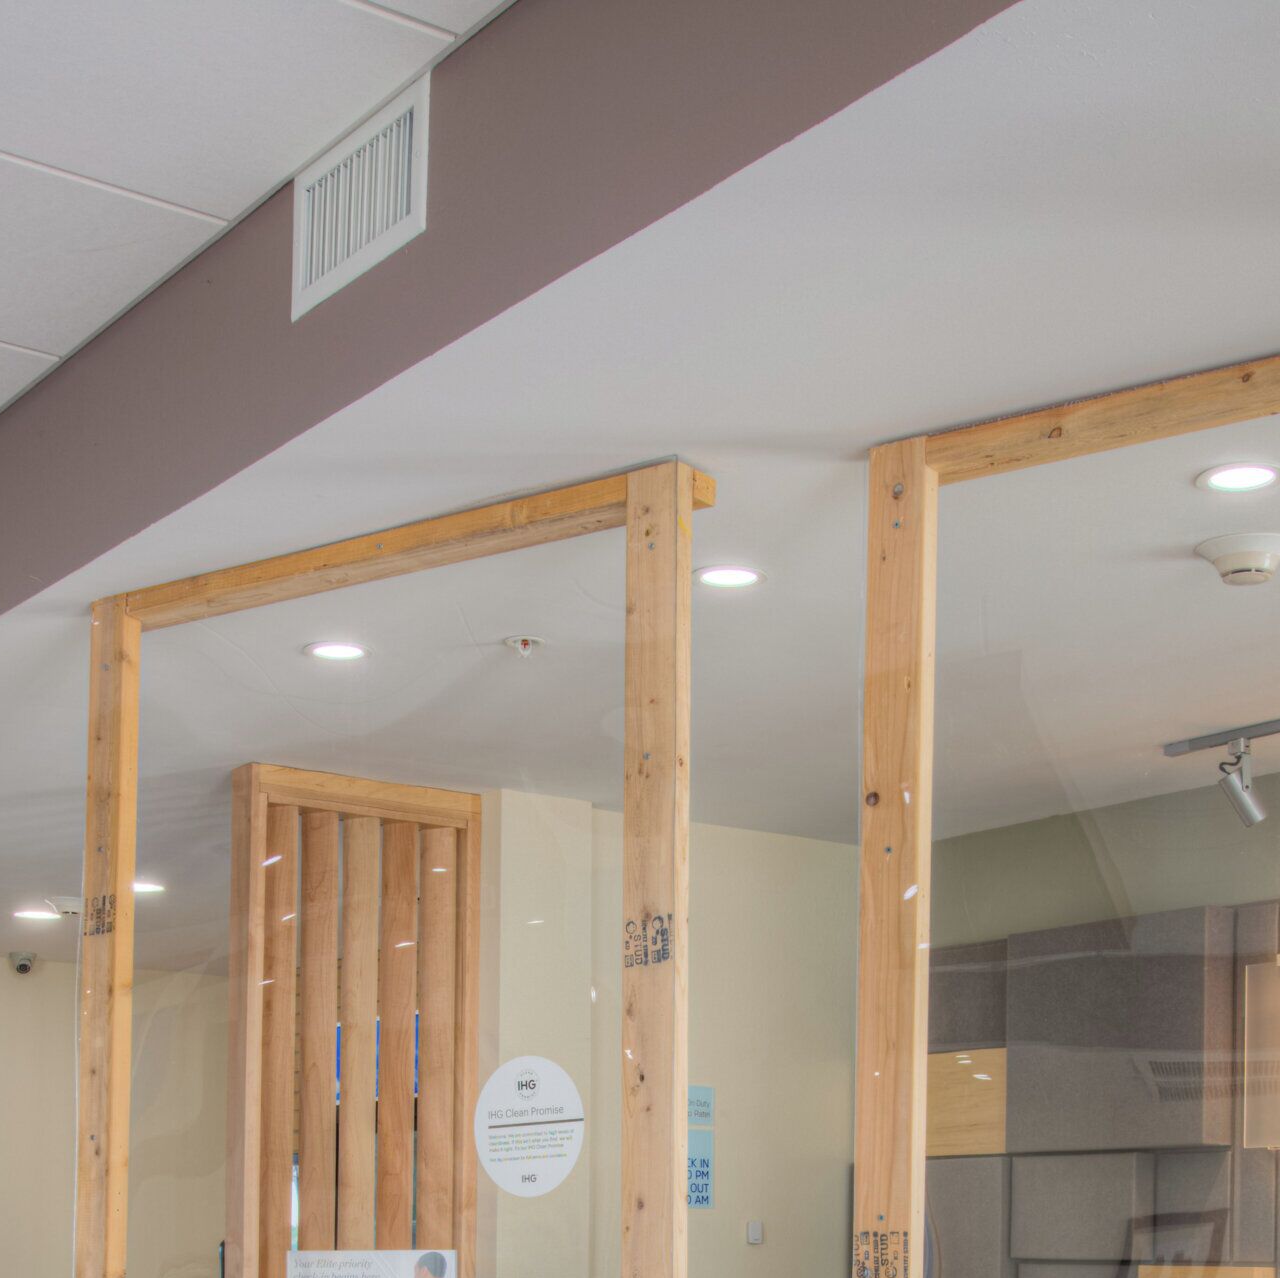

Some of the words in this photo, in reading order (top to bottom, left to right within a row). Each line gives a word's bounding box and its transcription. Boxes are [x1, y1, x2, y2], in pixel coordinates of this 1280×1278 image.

[660, 928, 670, 960] STUD
[517, 1079, 537, 1091] IHG
[488, 1109, 504, 1121] IHG
[505, 1108, 529, 1118] Clean
[530, 1104, 564, 1116] Promise
[700, 1157, 710, 1169] IN
[521, 1173, 537, 1184] IHG
[695, 1169, 710, 1180] PM
[690, 1182, 710, 1193] OUT
[694, 1195, 709, 1205] AM
[880, 1233, 890, 1267] STUD
[294, 1259, 314, 1269] Your
[316, 1258, 337, 1269] Elite
[337, 1258, 372, 1271] priority
